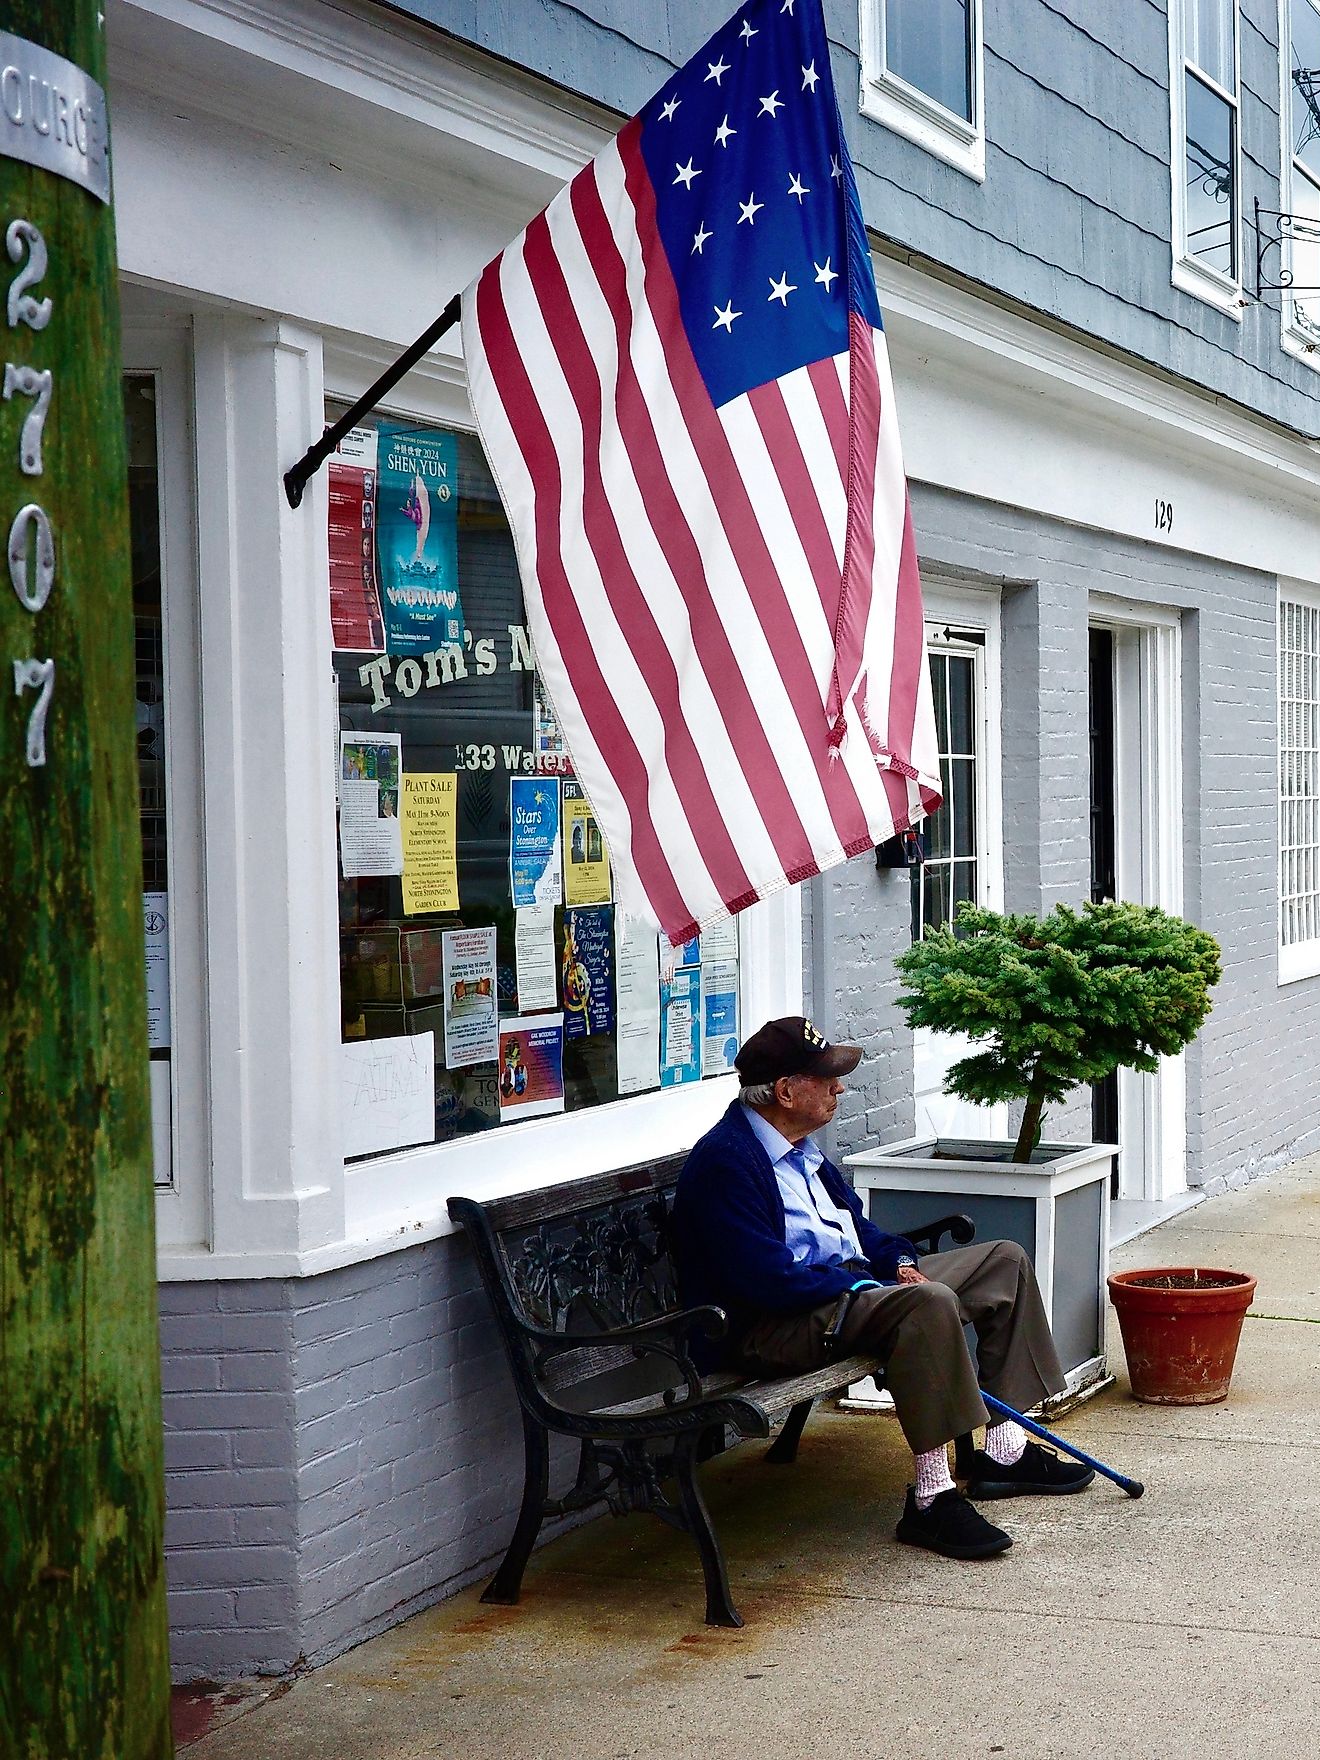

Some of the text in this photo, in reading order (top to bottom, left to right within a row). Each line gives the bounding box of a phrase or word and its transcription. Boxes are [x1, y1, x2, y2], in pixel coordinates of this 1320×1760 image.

[422, 448, 440, 460] 2024
[388, 453, 417, 474] SHEN
[419, 459, 448, 478] YUN
[1154, 499, 1173, 534] 129
[358, 630, 498, 714] Tom's
[501, 745, 567, 772] Water
[405, 778, 453, 792] PLANT SALE
[412, 795, 442, 805] SATURDAY
[406, 809, 417, 819] MAY
[515, 806, 542, 825] Stars
[523, 825, 537, 835] Over
[516, 835, 548, 848] Stonington
[408, 888, 452, 897] NORTH STONINGTON
[414, 899, 447, 909] GARDEN CLUB
